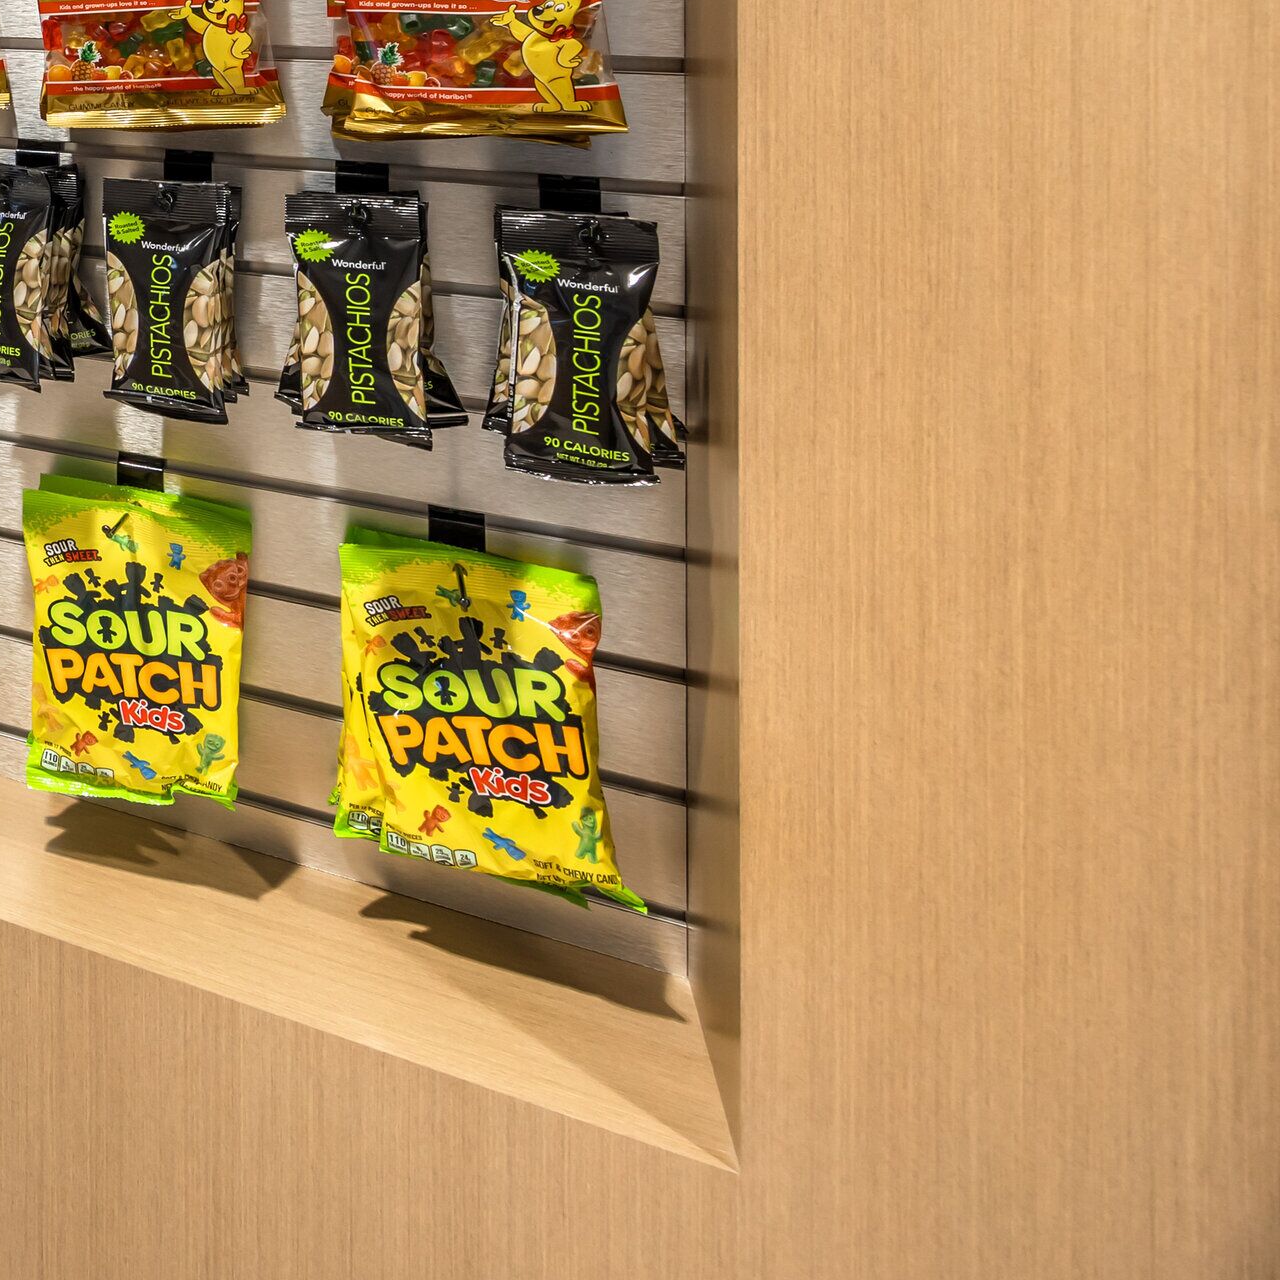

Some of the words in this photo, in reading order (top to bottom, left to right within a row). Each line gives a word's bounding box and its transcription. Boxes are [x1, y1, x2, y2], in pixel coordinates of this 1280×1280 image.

[332, 258, 385, 270] Wonderful
[557, 278, 619, 293] Wonderful
[149, 254, 173, 378] PISTACHIOS
[345, 273, 376, 405] PISTACHIOS
[572, 293, 602, 436] PISTACHIOS
[131, 382, 144, 392] 90
[146, 385, 196, 400] CALORIES
[328, 411, 343, 421] 90
[345, 413, 404, 427] CALORIES
[544, 436, 560, 448] 90
[563, 440, 630, 462] CALORIES
[46, 539, 77, 557] SOUR
[44, 553, 64, 566] THEN
[364, 595, 402, 614] SOUR
[366, 612, 390, 626] THEN
[50, 601, 205, 661] SOUR
[45, 647, 219, 709] PATCH
[380, 663, 567, 723] SOUR
[119, 699, 185, 733] Kids
[45, 751, 58, 762] 110
[377, 714, 586, 778] PATCH
[469, 767, 551, 805] Kids
[390, 835, 405, 847] 110
[533, 860, 553, 869] SOFT
[563, 868, 594, 881] CHEWY
